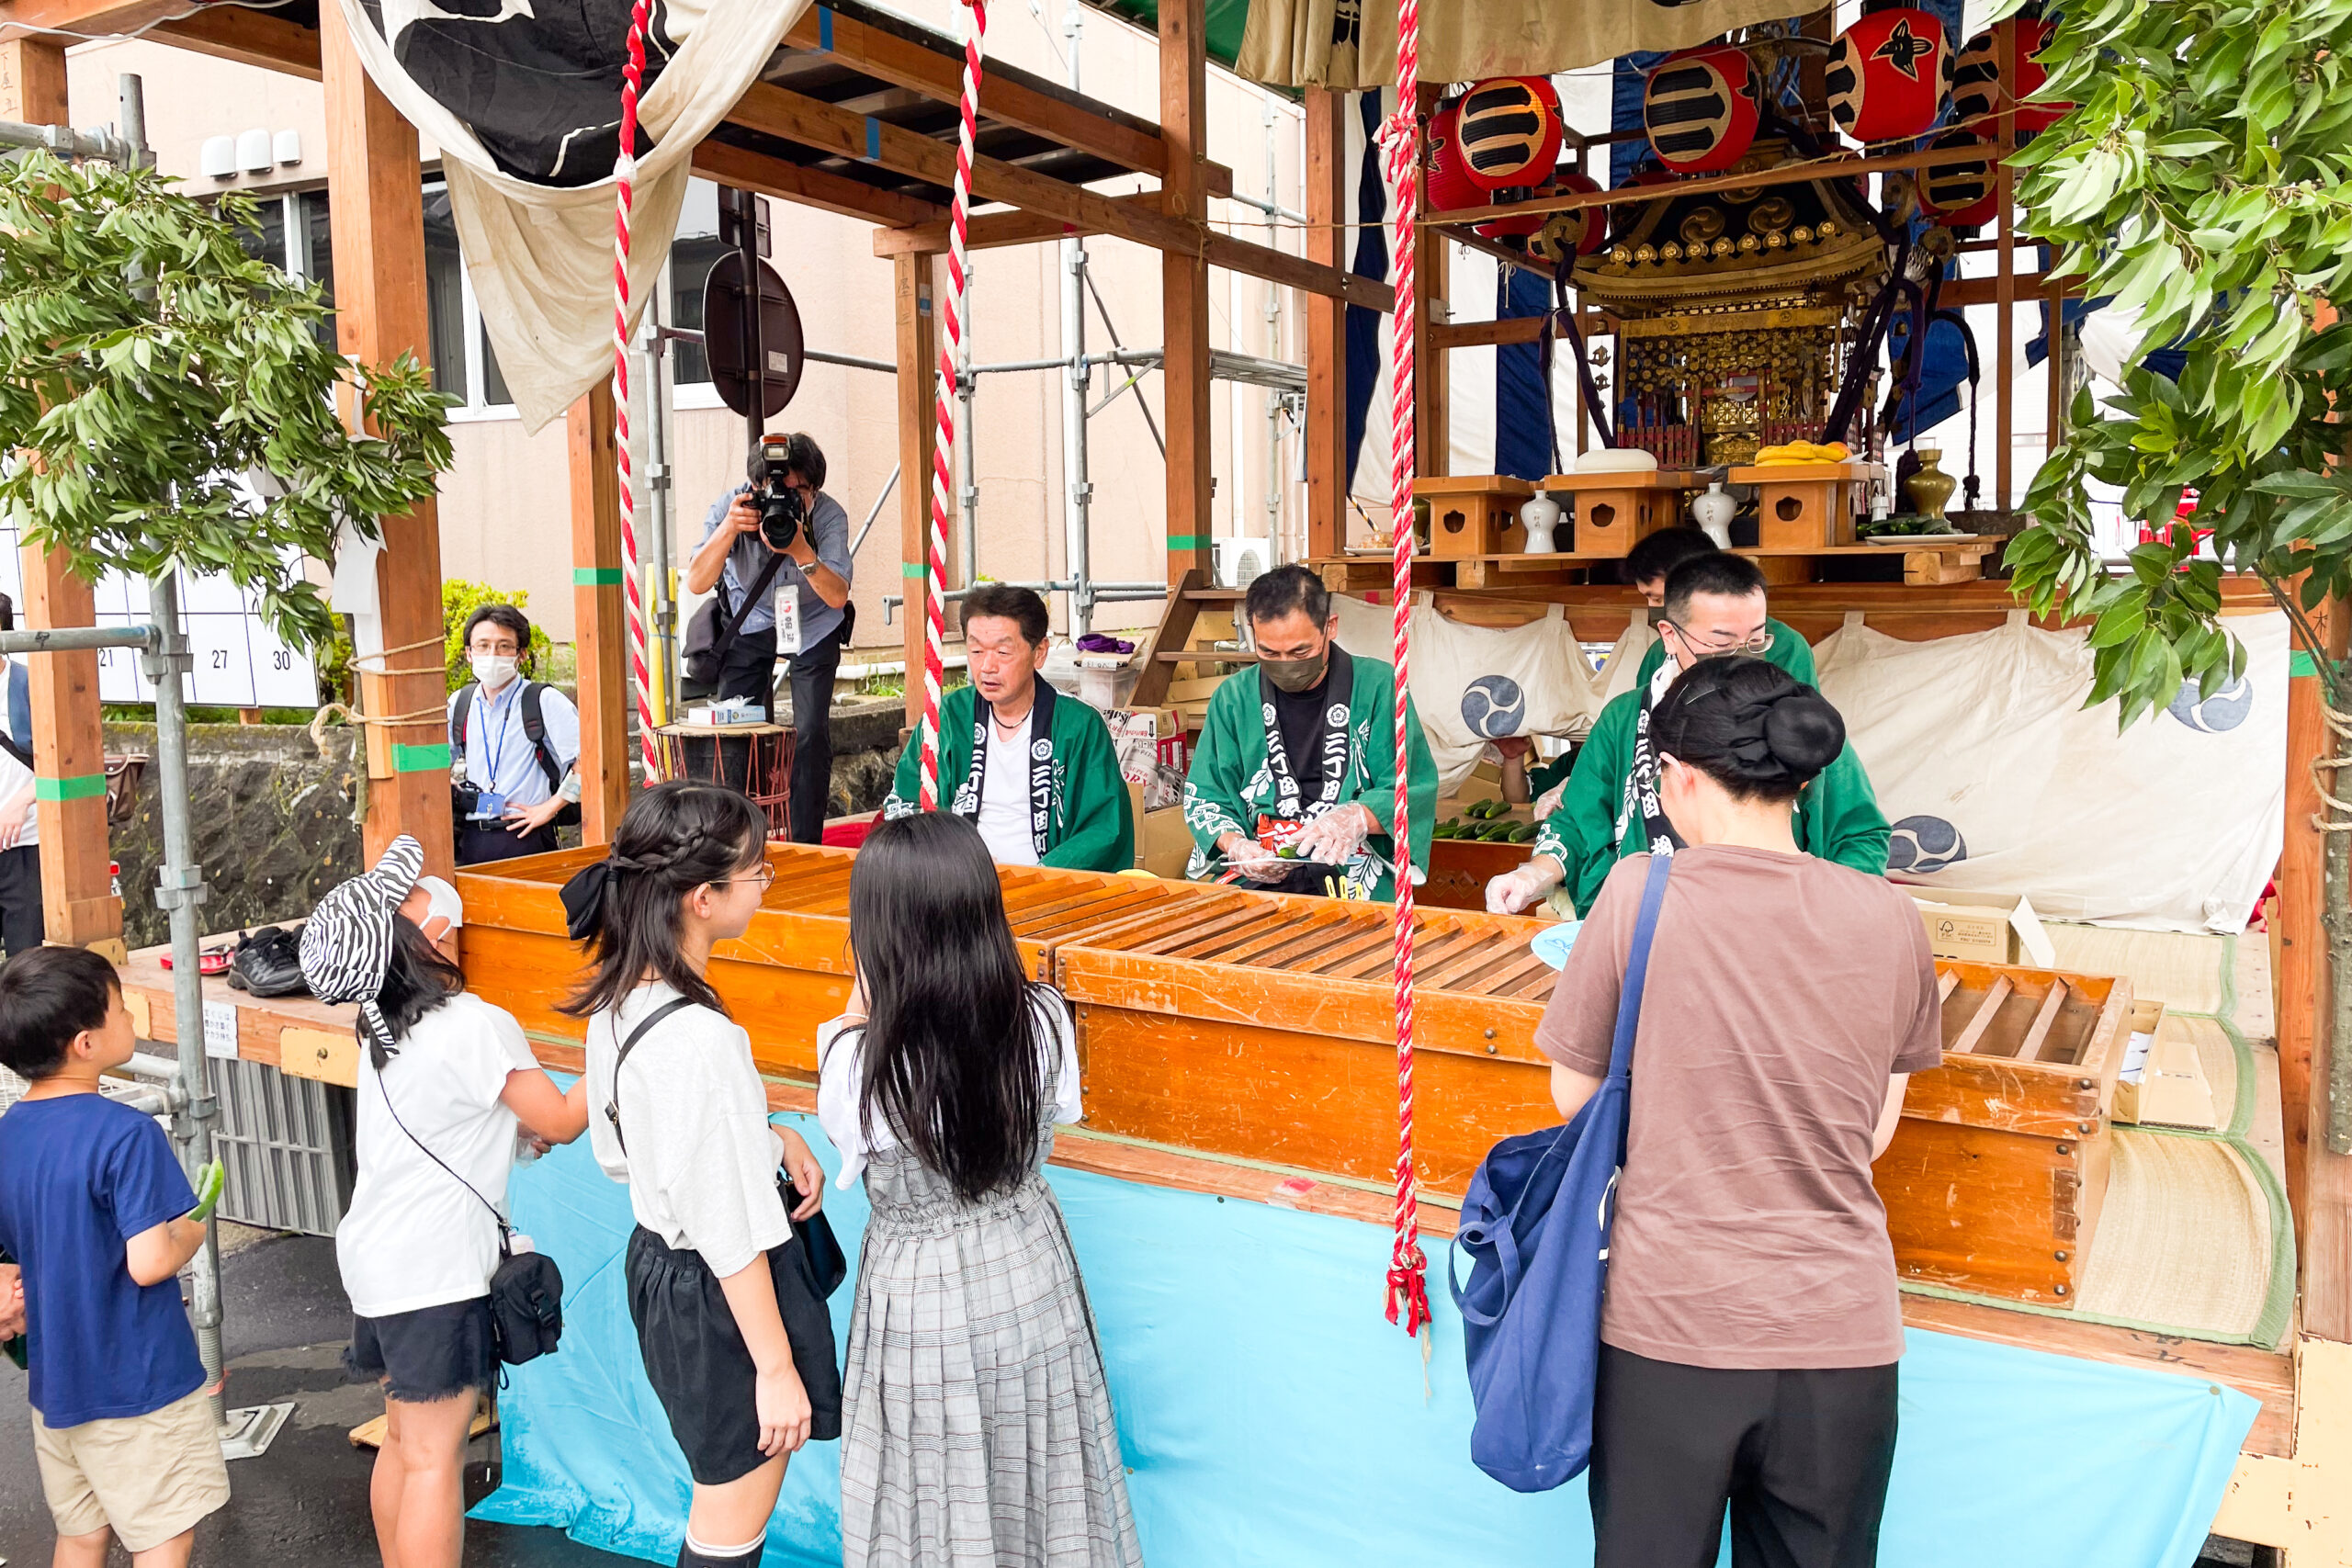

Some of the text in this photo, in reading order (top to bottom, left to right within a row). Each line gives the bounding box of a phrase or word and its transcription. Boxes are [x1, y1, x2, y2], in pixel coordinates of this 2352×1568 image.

[1646, 66, 1725, 154] 三
[1462, 85, 1540, 171] 三
[99, 649, 114, 668] 21
[212, 649, 228, 670] 27
[273, 650, 291, 671] 30
